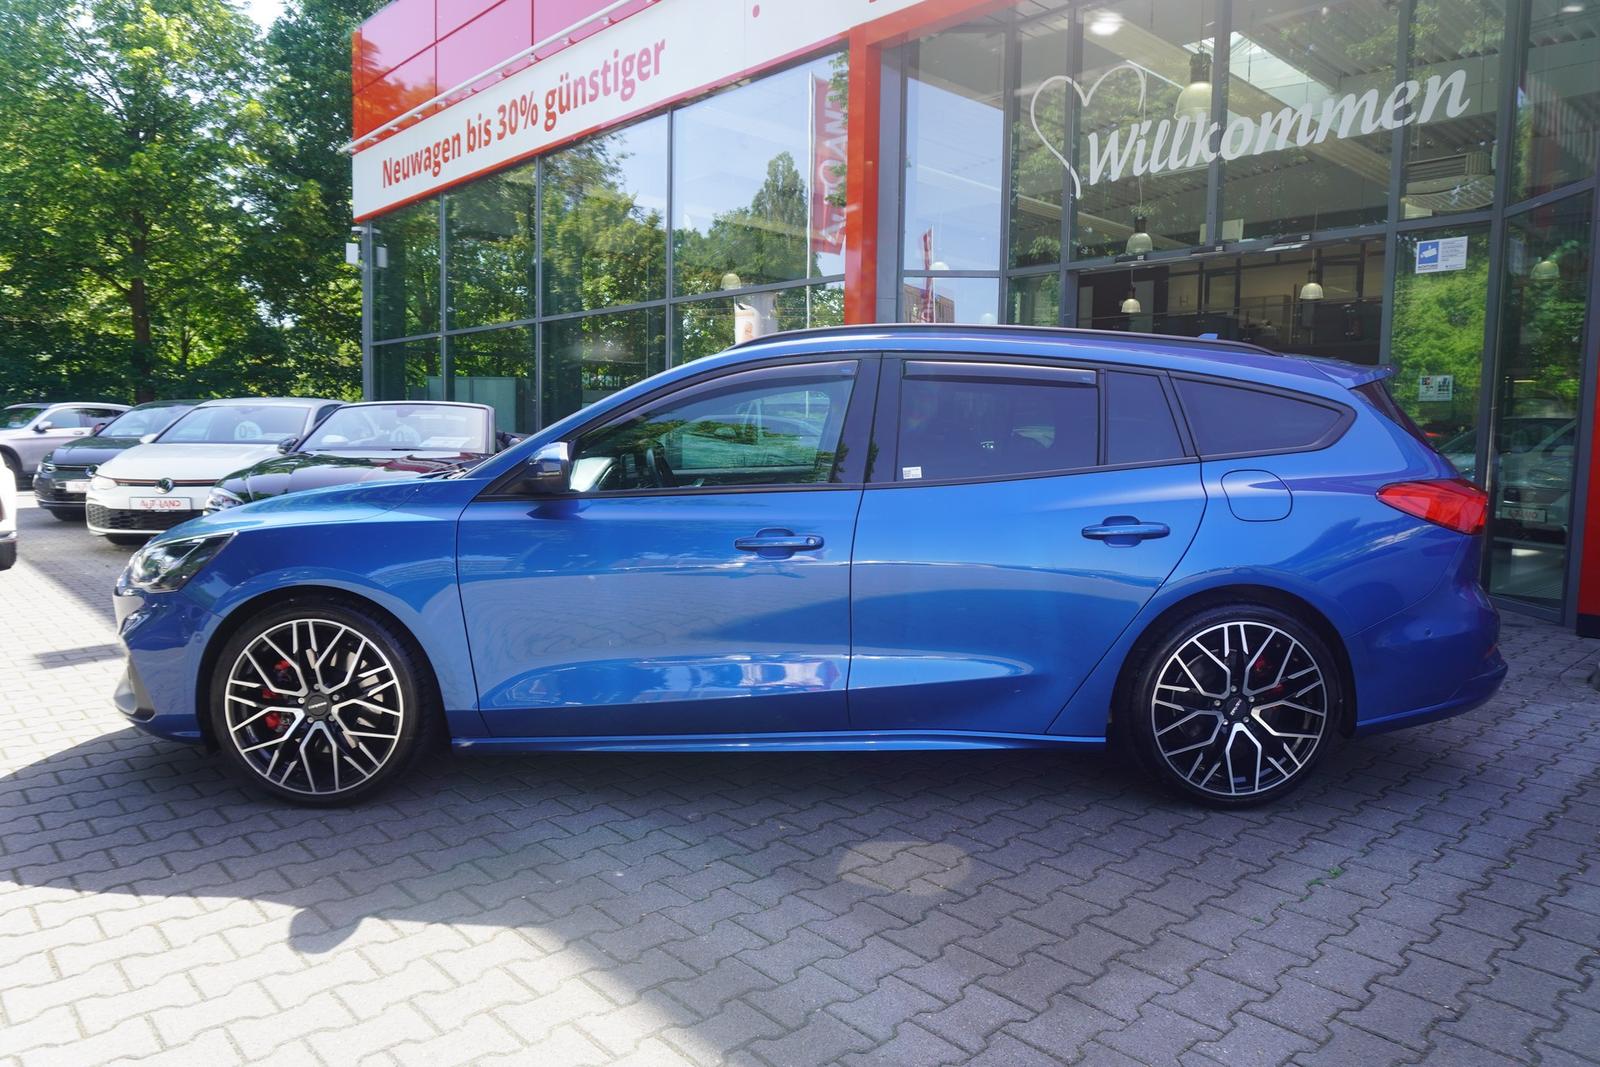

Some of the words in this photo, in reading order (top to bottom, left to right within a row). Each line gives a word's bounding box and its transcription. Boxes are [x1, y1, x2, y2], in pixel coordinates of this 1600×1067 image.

[383, 132, 461, 188] Neuwagen
[466, 114, 492, 153] bis
[497, 91, 538, 141] 30%
[544, 39, 665, 132] günstiger
[1088, 69, 1470, 186] Willkommen
